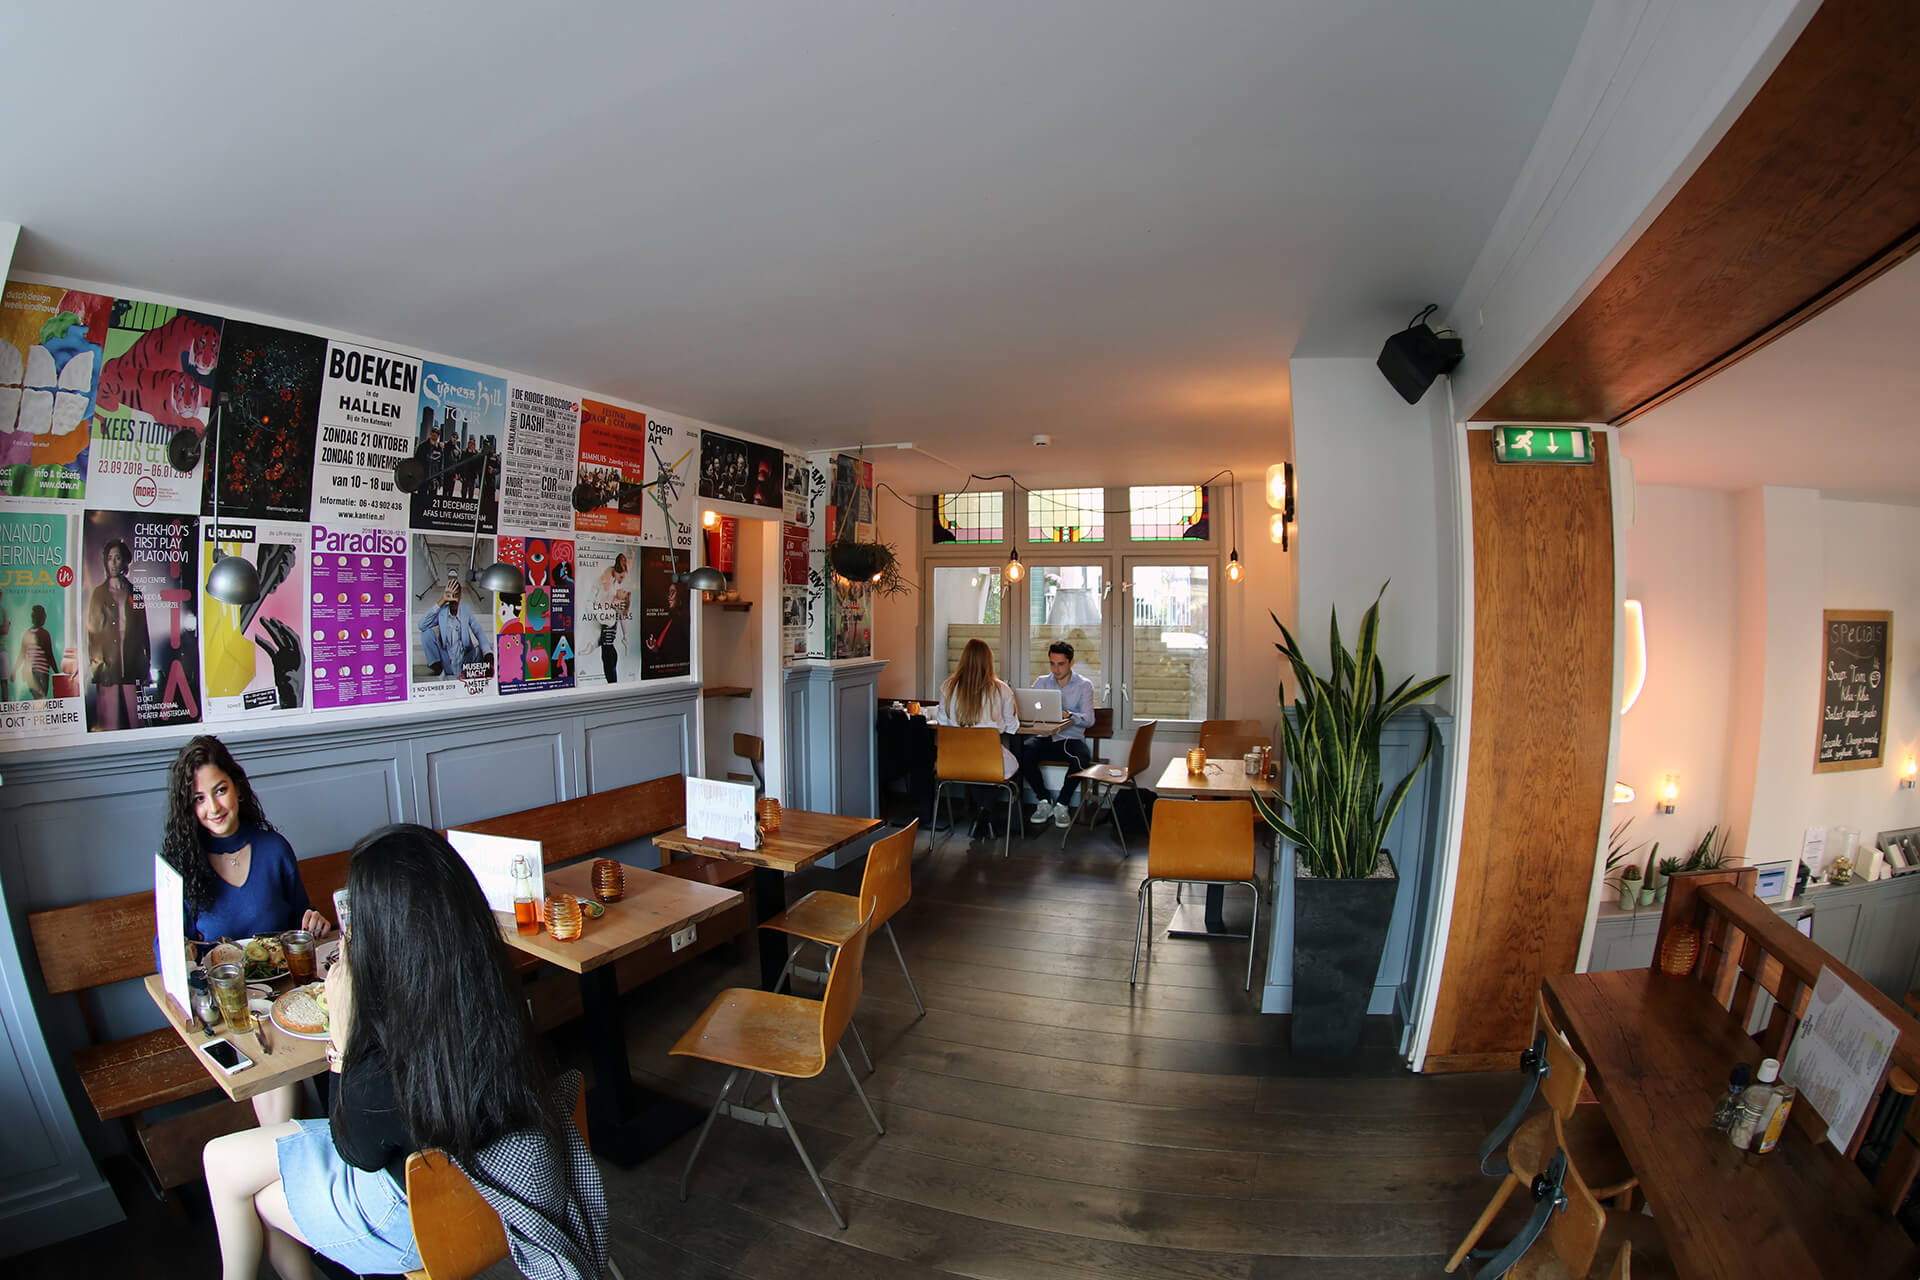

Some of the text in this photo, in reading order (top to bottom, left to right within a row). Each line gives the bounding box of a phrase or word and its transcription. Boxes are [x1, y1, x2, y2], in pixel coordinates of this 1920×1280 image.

[329, 347, 418, 394] BOEKEN
[422, 373, 476, 408] Cypress
[515, 389, 524, 401] DE
[524, 391, 545, 405] ROODE
[339, 395, 401, 419] HALLEN
[444, 405, 480, 424] TOUR
[520, 413, 545, 433] DASH!
[648, 420, 673, 436] Open
[101, 416, 197, 446] KEES TIMM
[322, 426, 409, 453] ZONDAG 21 OKTOBER
[647, 433, 663, 446] Art
[321, 447, 354, 465] ZONDAG
[356, 452, 366, 466] 18
[33, 469, 49, 478] info
[56, 470, 81, 480] tickets
[98, 460, 122, 474] 23.09
[123, 461, 143, 475] 2018
[39, 480, 80, 490] www.ddw.nl
[332, 475, 348, 487] van
[350, 475, 361, 488] 10
[370, 477, 380, 490] 18
[381, 482, 394, 491] uur
[541, 476, 558, 492] COR
[135, 486, 156, 497] MORE
[320, 495, 357, 506] Informatie:
[432, 499, 440, 508] 21
[422, 509, 439, 518] AFAS
[439, 511, 452, 519] LIVE
[134, 523, 190, 537] CHEKHOV'S
[134, 536, 183, 550] FIRST PLAY
[311, 525, 407, 554] Paradiso
[592, 602, 627, 611] LA DAME
[582, 612, 598, 621] AUX
[462, 662, 490, 671] MUSEUM
[466, 669, 486, 678] NACHT
[417, 685, 445, 693] NOVEMBER
[137, 710, 191, 719] THEATER AMSTERDAM
[5, 716, 25, 729] OKT
